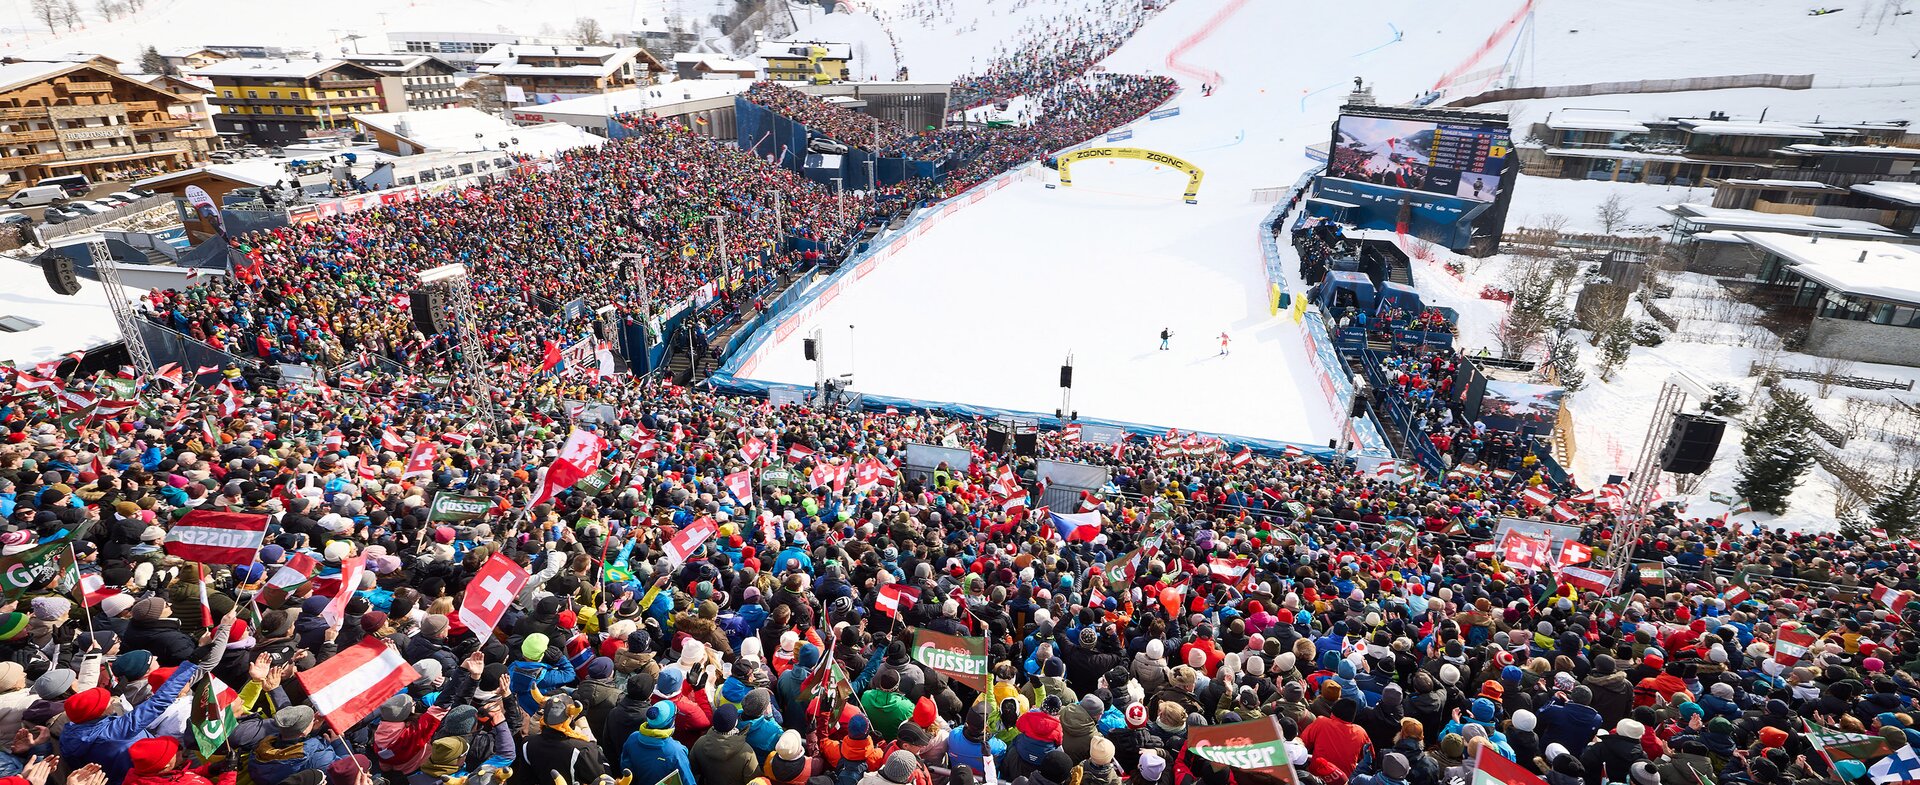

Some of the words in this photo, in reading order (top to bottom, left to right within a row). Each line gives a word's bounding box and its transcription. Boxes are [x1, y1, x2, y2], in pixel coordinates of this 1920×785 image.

[1077, 149, 1112, 158] ZGONC
[1146, 152, 1183, 168] ZGONC
[584, 474, 605, 488] sser
[436, 496, 486, 514] Gösser
[918, 641, 984, 675] Gösser
[1196, 740, 1275, 769] Gösser
